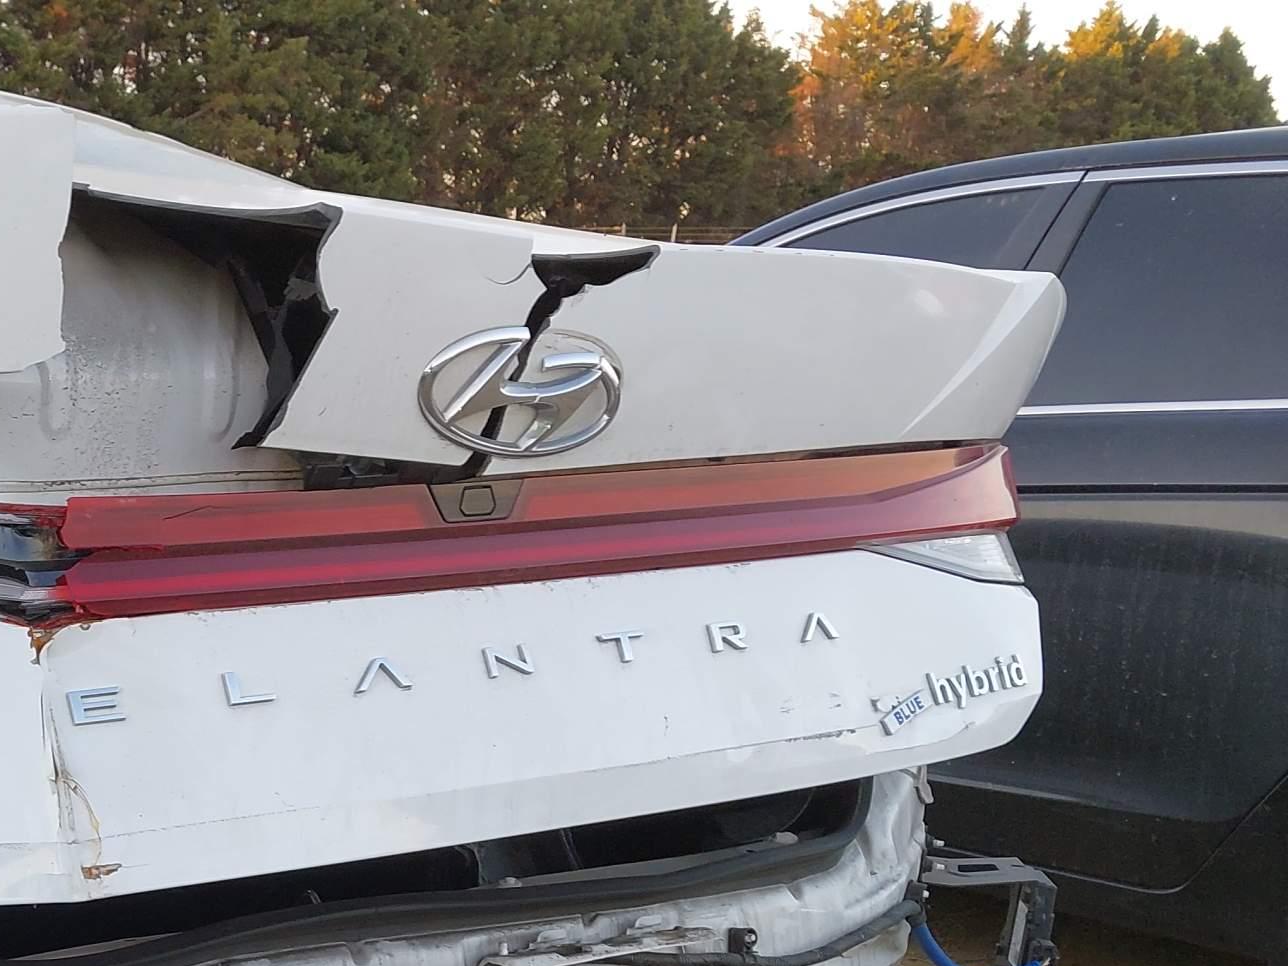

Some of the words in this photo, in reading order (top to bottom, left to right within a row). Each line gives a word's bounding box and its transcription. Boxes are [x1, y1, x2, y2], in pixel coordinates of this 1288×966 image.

[65, 611, 841, 726] ELANTRA
[893, 695, 925, 726] BLUE
[925, 654, 1027, 709] hybrid
